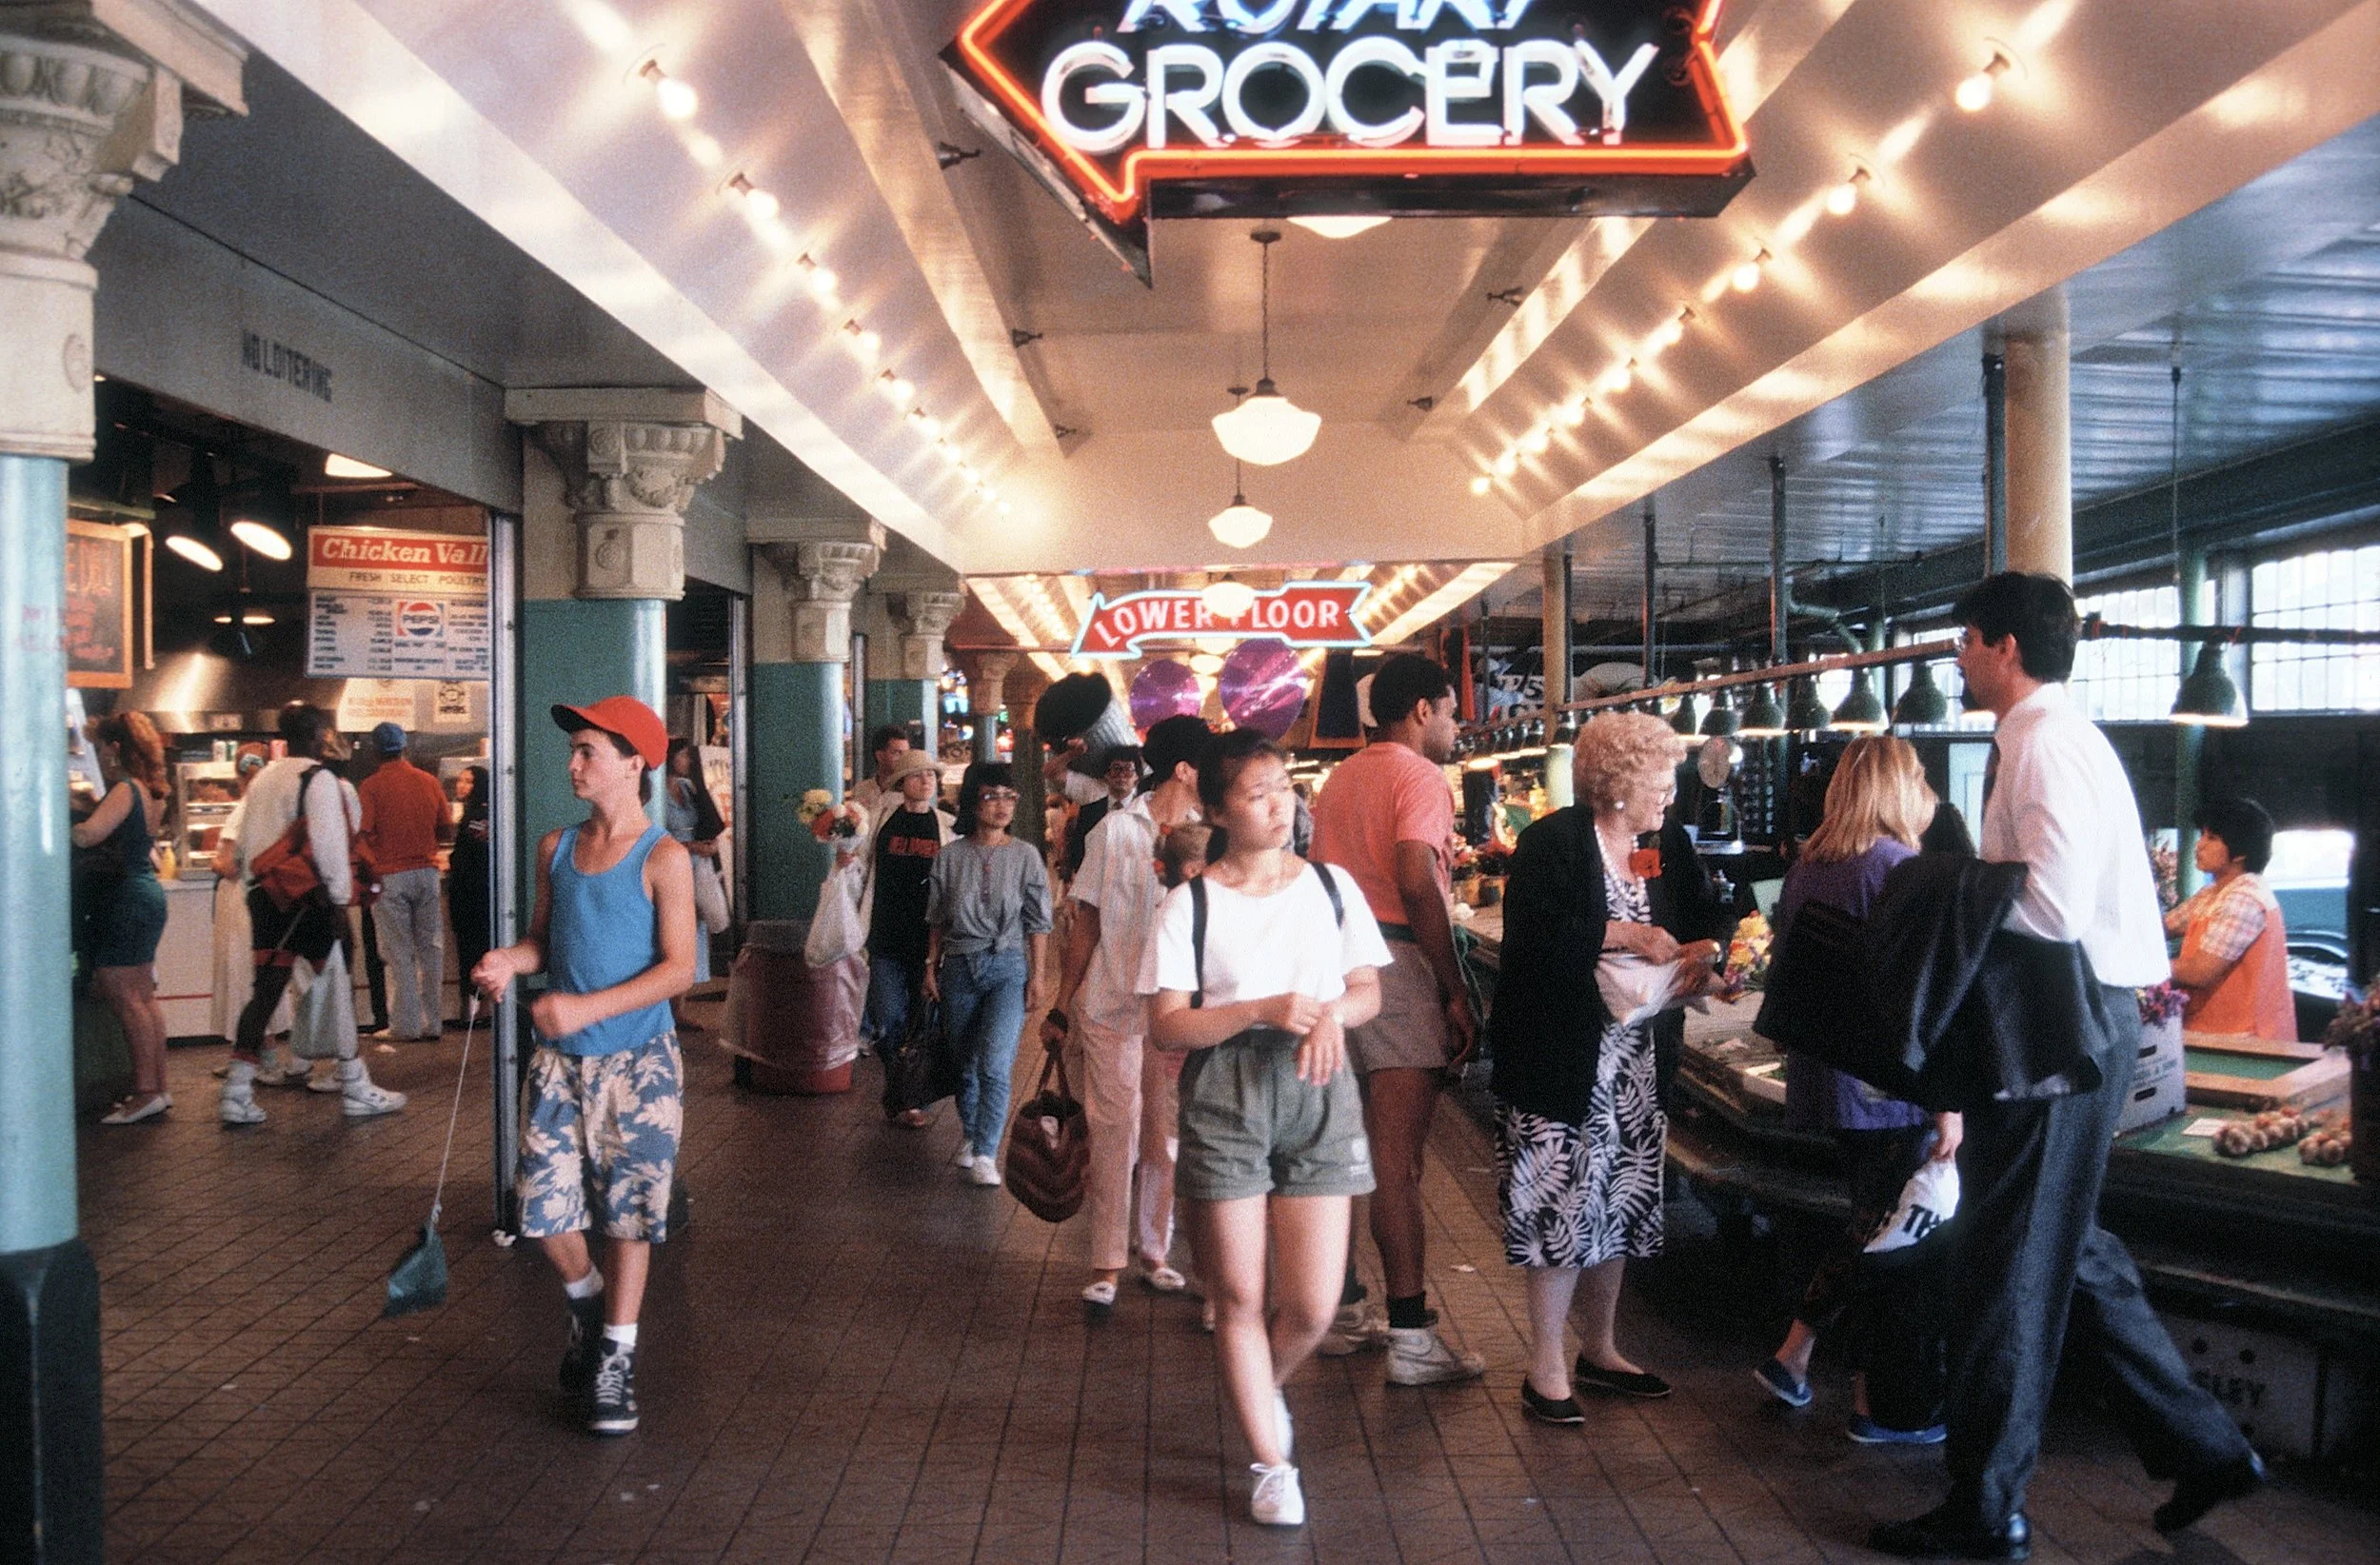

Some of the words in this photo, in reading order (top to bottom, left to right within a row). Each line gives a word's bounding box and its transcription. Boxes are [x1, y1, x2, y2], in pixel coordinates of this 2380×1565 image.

[1041, 35, 1659, 154] GROCERY
[322, 537, 431, 564] Chicken
[349, 571, 381, 582] FRESH
[390, 573, 429, 584] SELECT
[438, 575, 486, 587] POULTRY
[1095, 598, 1213, 648] LOWER
